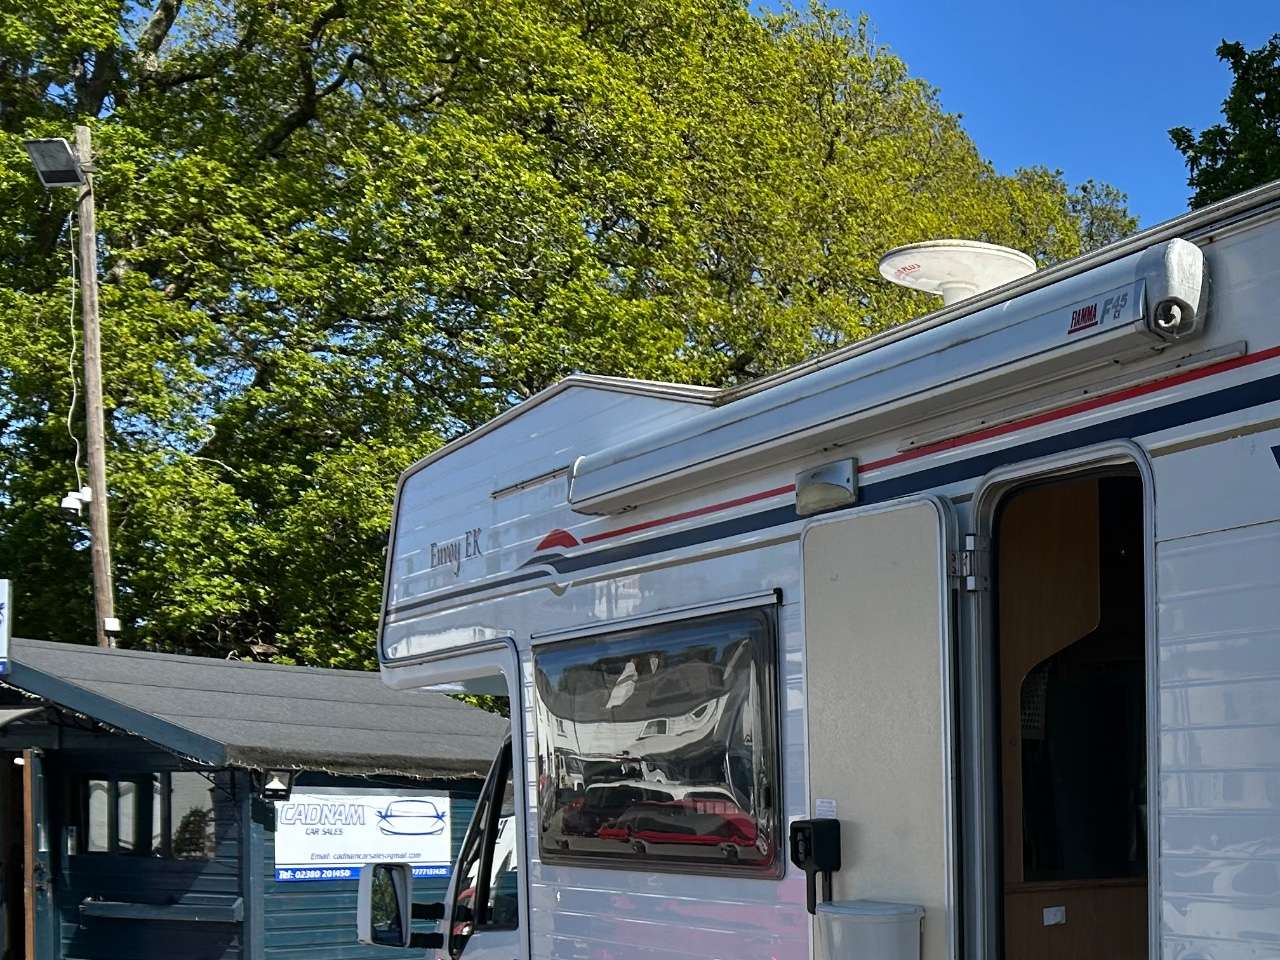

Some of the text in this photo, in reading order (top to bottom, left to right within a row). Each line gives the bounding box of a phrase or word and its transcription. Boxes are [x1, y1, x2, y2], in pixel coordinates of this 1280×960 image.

[1070, 303, 1098, 330] FIAMMA
[465, 528, 484, 558] EK
[279, 803, 367, 826] CADNAM
[305, 828, 344, 836] CAR SALES
